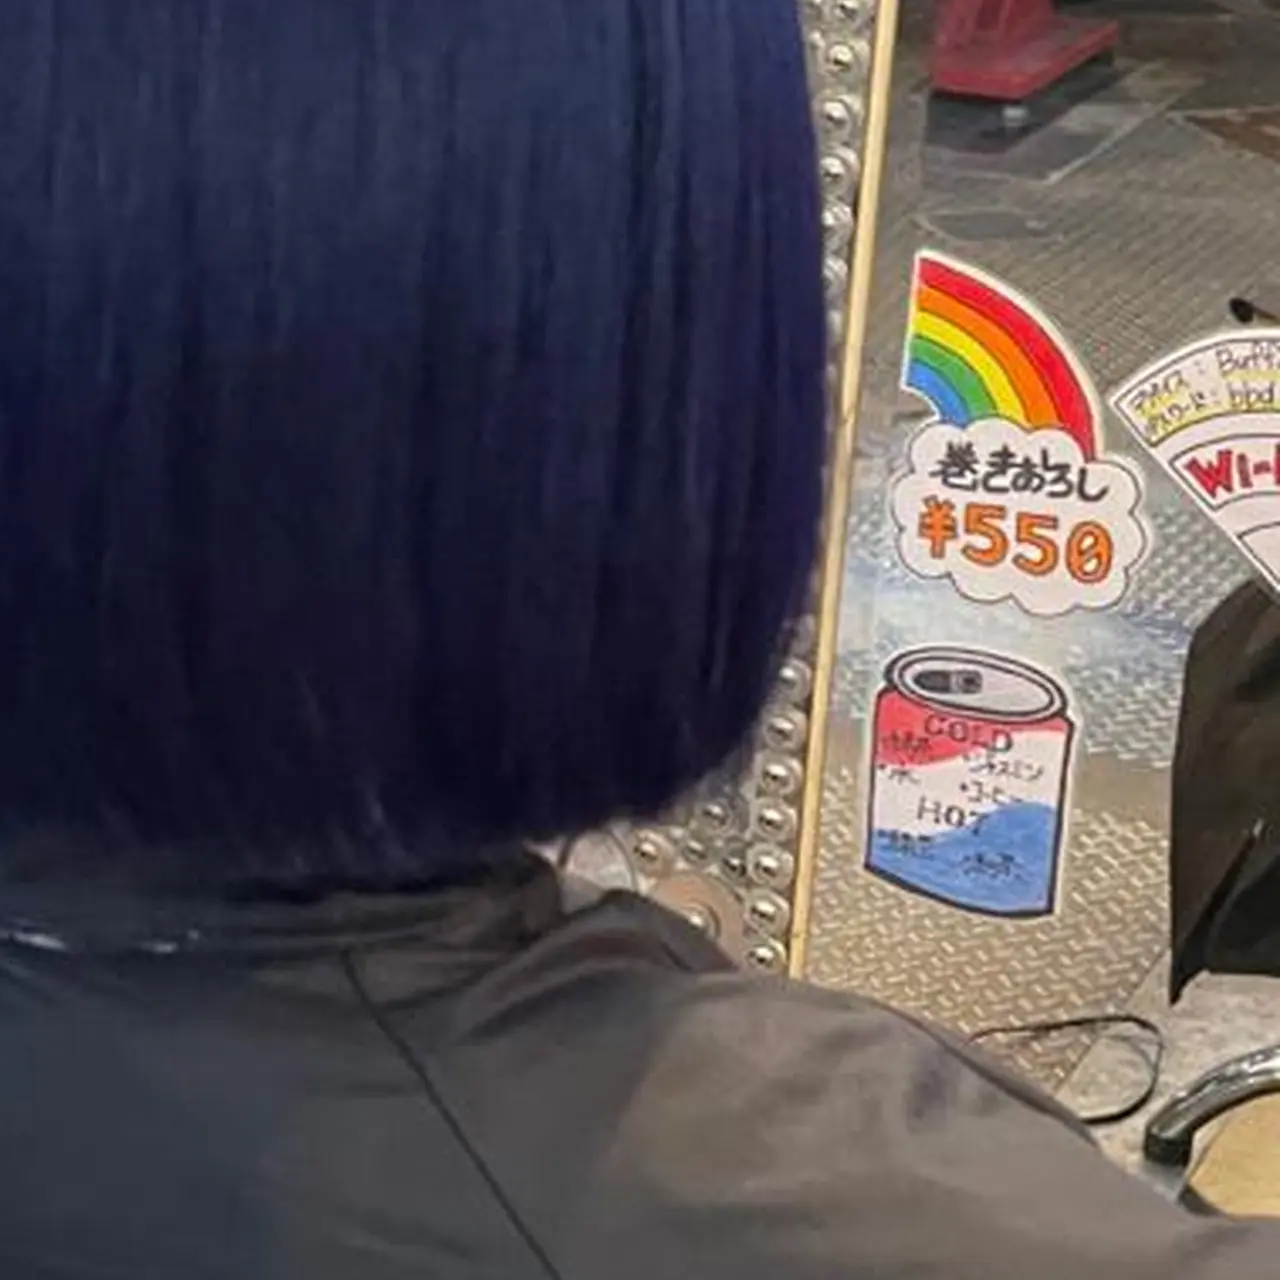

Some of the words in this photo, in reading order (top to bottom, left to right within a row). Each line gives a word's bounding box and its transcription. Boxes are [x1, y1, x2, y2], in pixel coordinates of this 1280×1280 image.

[1184, 444, 1280, 500] WI-
[917, 494, 1114, 584] ¥550
[924, 713, 1014, 754] COLD
[917, 793, 990, 838] HOT
